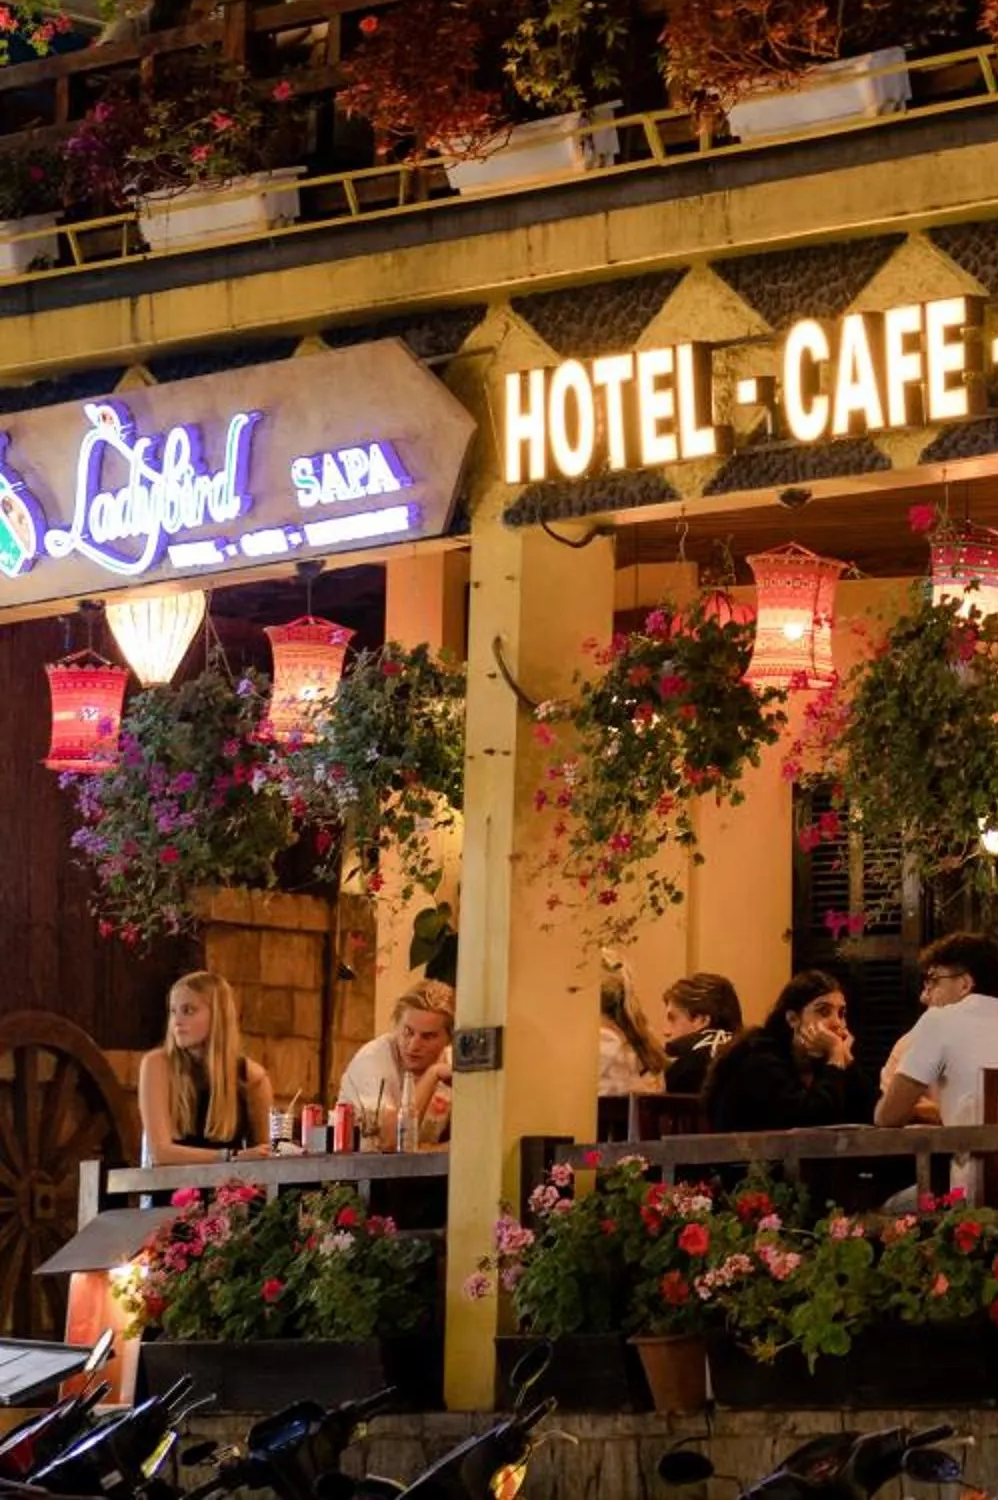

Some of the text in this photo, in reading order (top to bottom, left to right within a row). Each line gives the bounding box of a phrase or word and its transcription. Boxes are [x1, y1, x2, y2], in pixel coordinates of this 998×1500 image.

[506, 345, 716, 483] HOTEL
[783, 299, 967, 441] CAFE
[44, 404, 254, 576] Ladybird
[291, 442, 401, 508] SAPA
